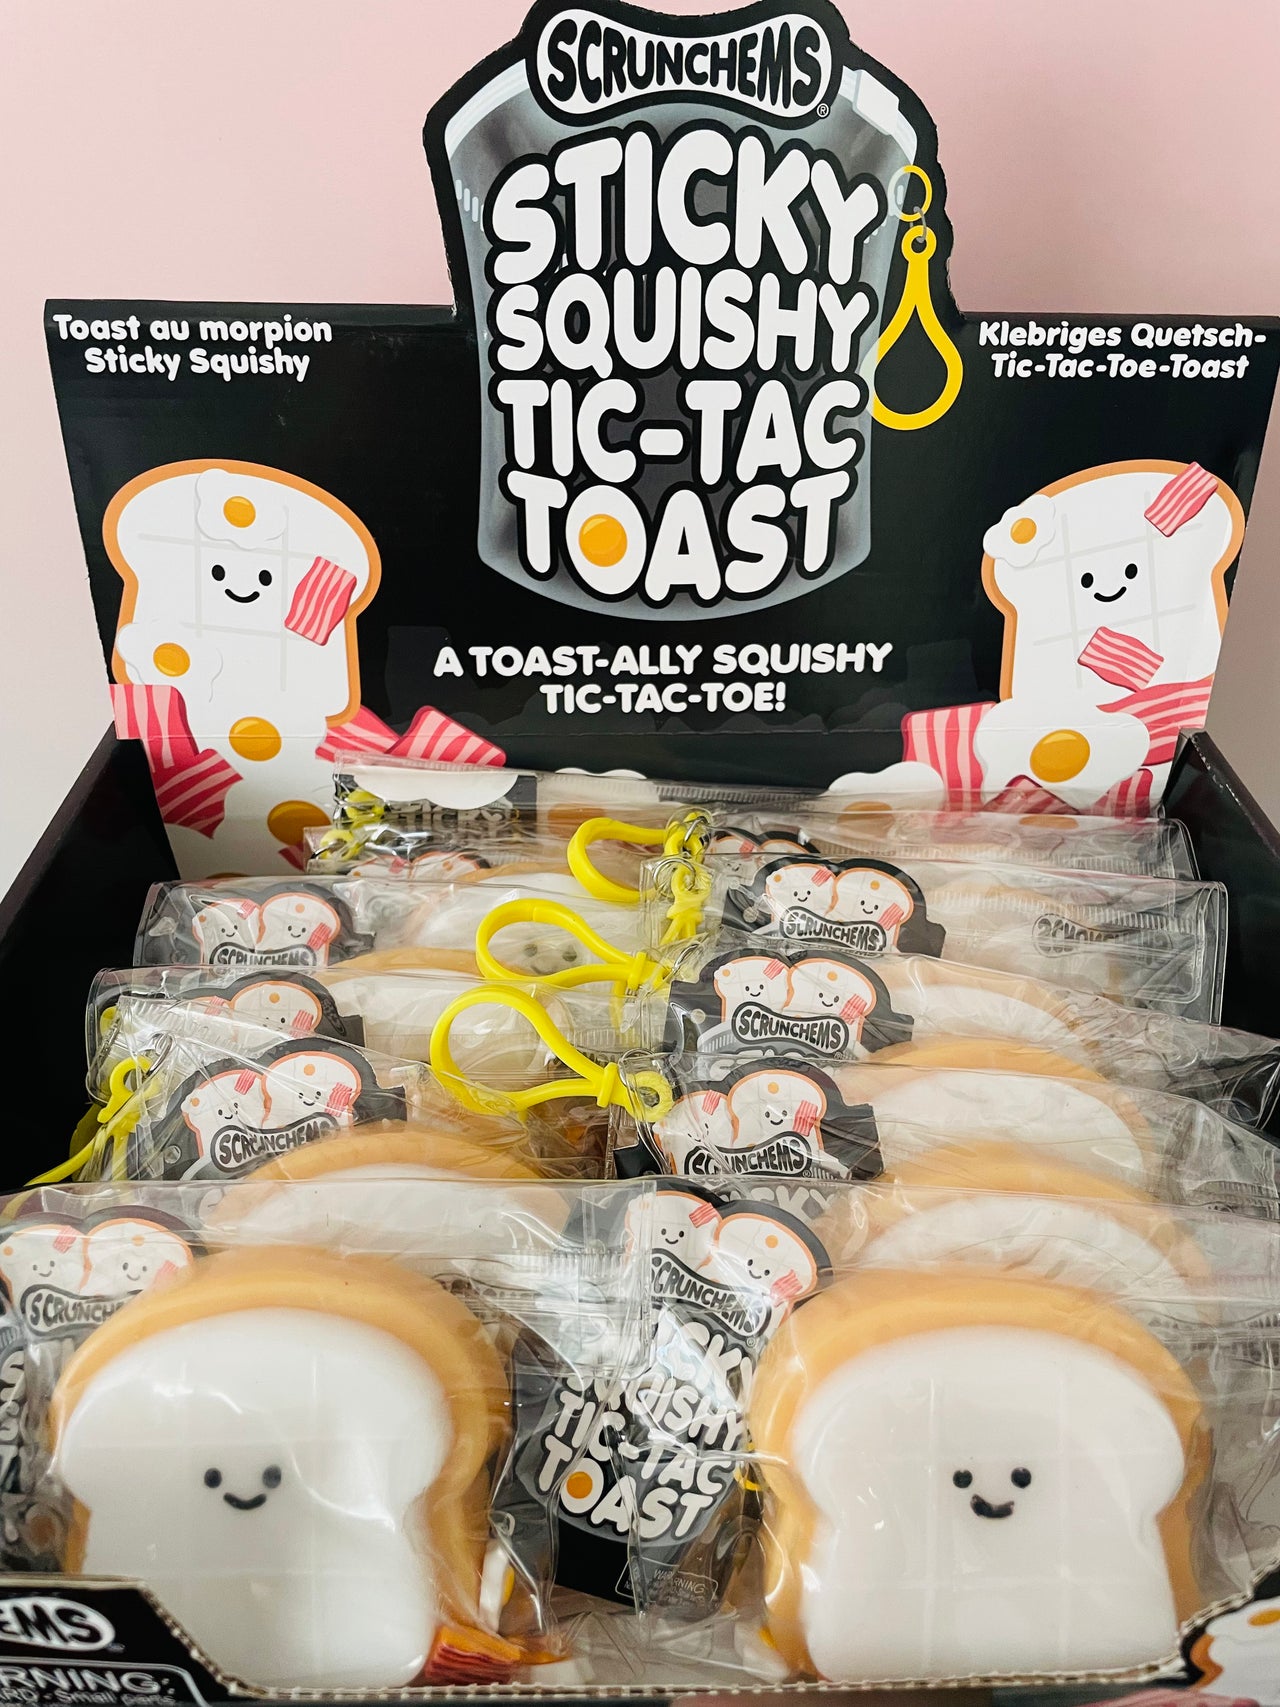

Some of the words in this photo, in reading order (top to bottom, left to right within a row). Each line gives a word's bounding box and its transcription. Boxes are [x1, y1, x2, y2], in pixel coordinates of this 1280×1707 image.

[546, 18, 823, 109] SCRUNCHEMS
[493, 129, 879, 285] STICKY
[52, 314, 140, 340] Toast
[150, 320, 190, 341] au
[199, 314, 333, 349] morpion
[497, 266, 871, 378] SQUISHY
[979, 320, 1122, 354] Klebriges
[1131, 323, 1267, 348] Quetsch-
[84, 345, 181, 381] Sticky
[189, 346, 310, 382] Squishy
[991, 351, 1250, 378] Tic-Tac-Toe-Toast
[497, 378, 862, 485] TIC-TAC
[506, 470, 852, 600] TOAST
[433, 646, 464, 677] A
[468, 644, 703, 676] TOAST-ALLY
[712, 642, 893, 677] SQUISHY
[539, 681, 787, 713] TIC-TAC-TOE!
[738, 1009, 842, 1050] SCRUNCHEMS
[692, 1139, 804, 1174] SCUNCHEMS
[539, 1434, 714, 1538] TOAST
